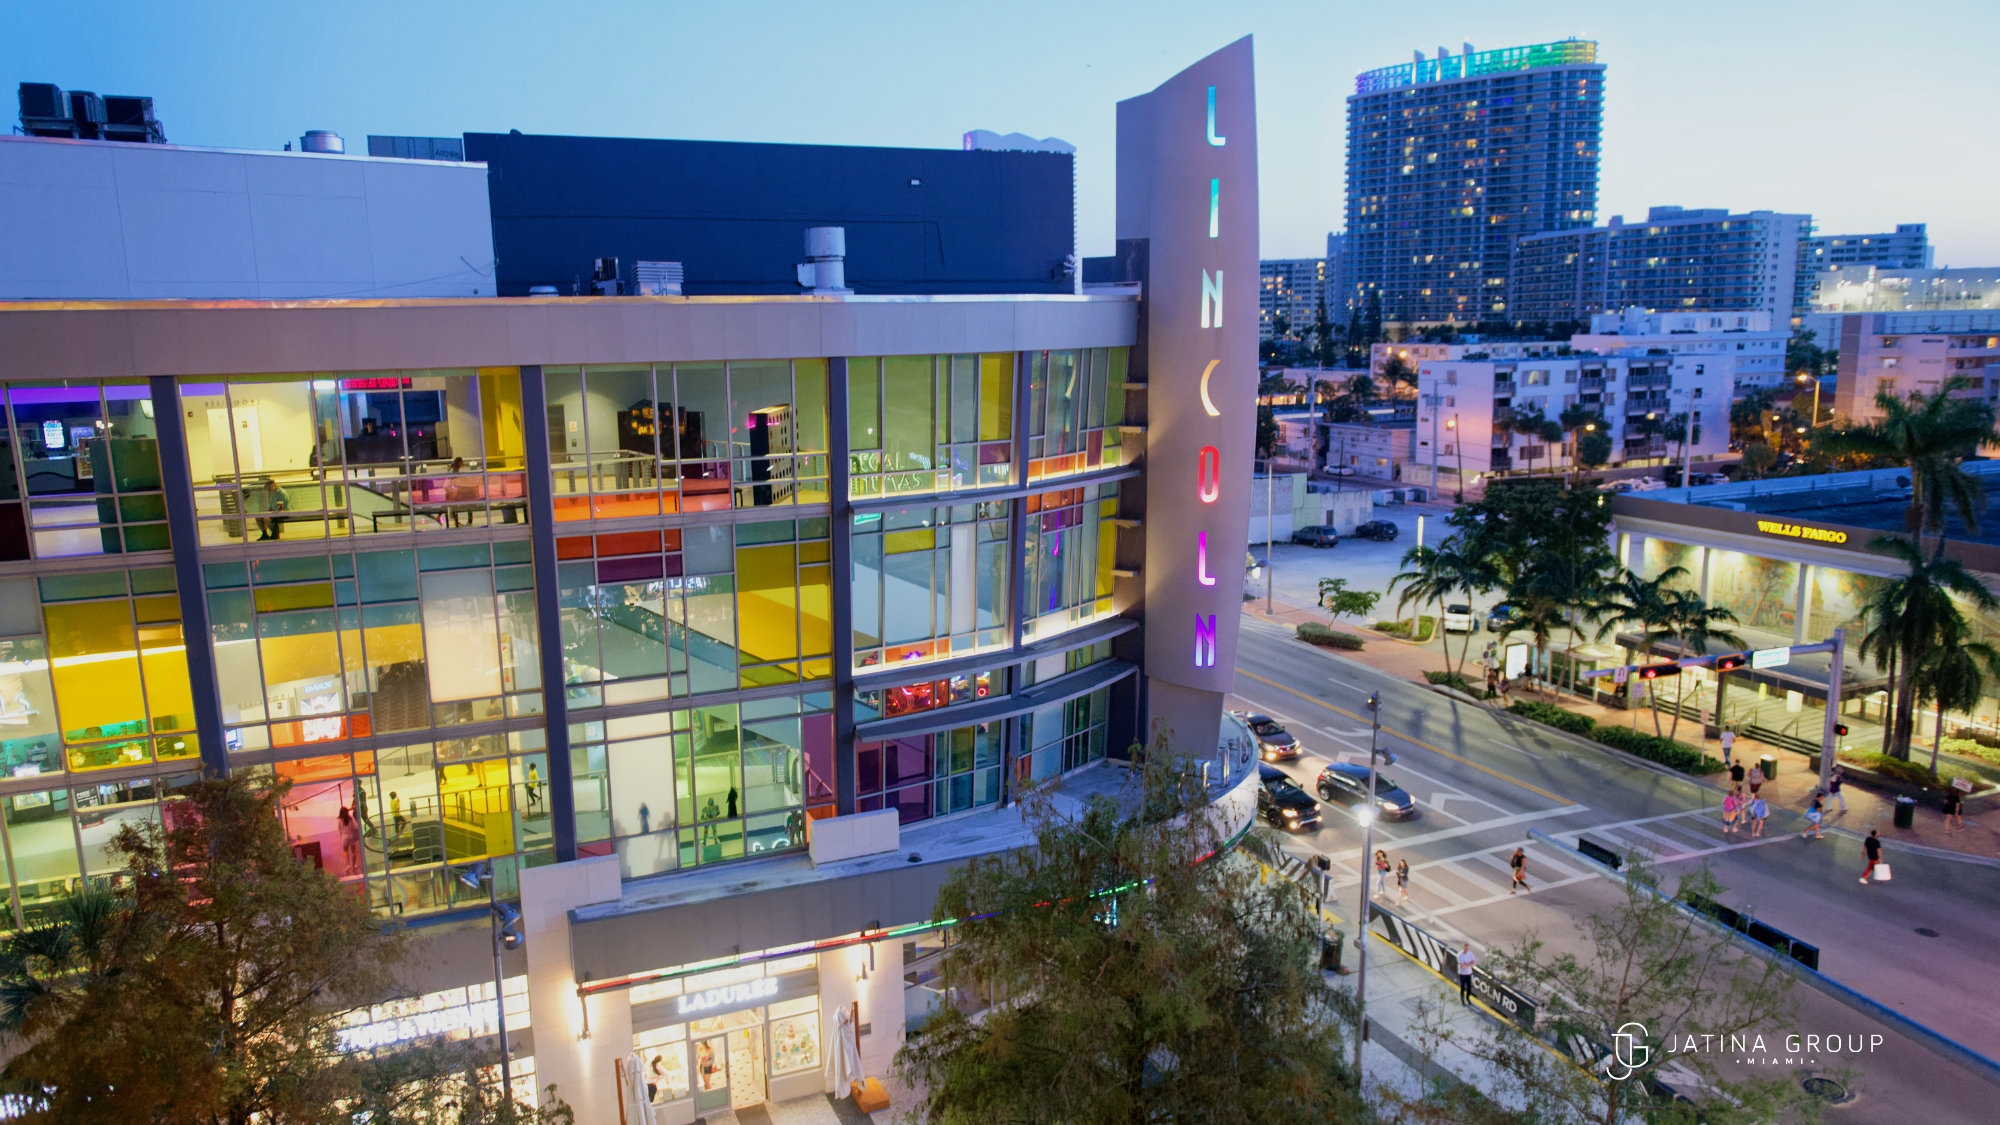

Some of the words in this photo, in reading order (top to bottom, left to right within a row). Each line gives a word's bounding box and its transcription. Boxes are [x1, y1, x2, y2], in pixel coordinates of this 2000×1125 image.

[1194, 85, 1226, 668] LINCOLN
[1757, 520, 1802, 538] WELLS
[1801, 526, 1847, 544] FARGO
[303, 680, 334, 694] IMAX
[1502, 995, 1518, 1014] RD
